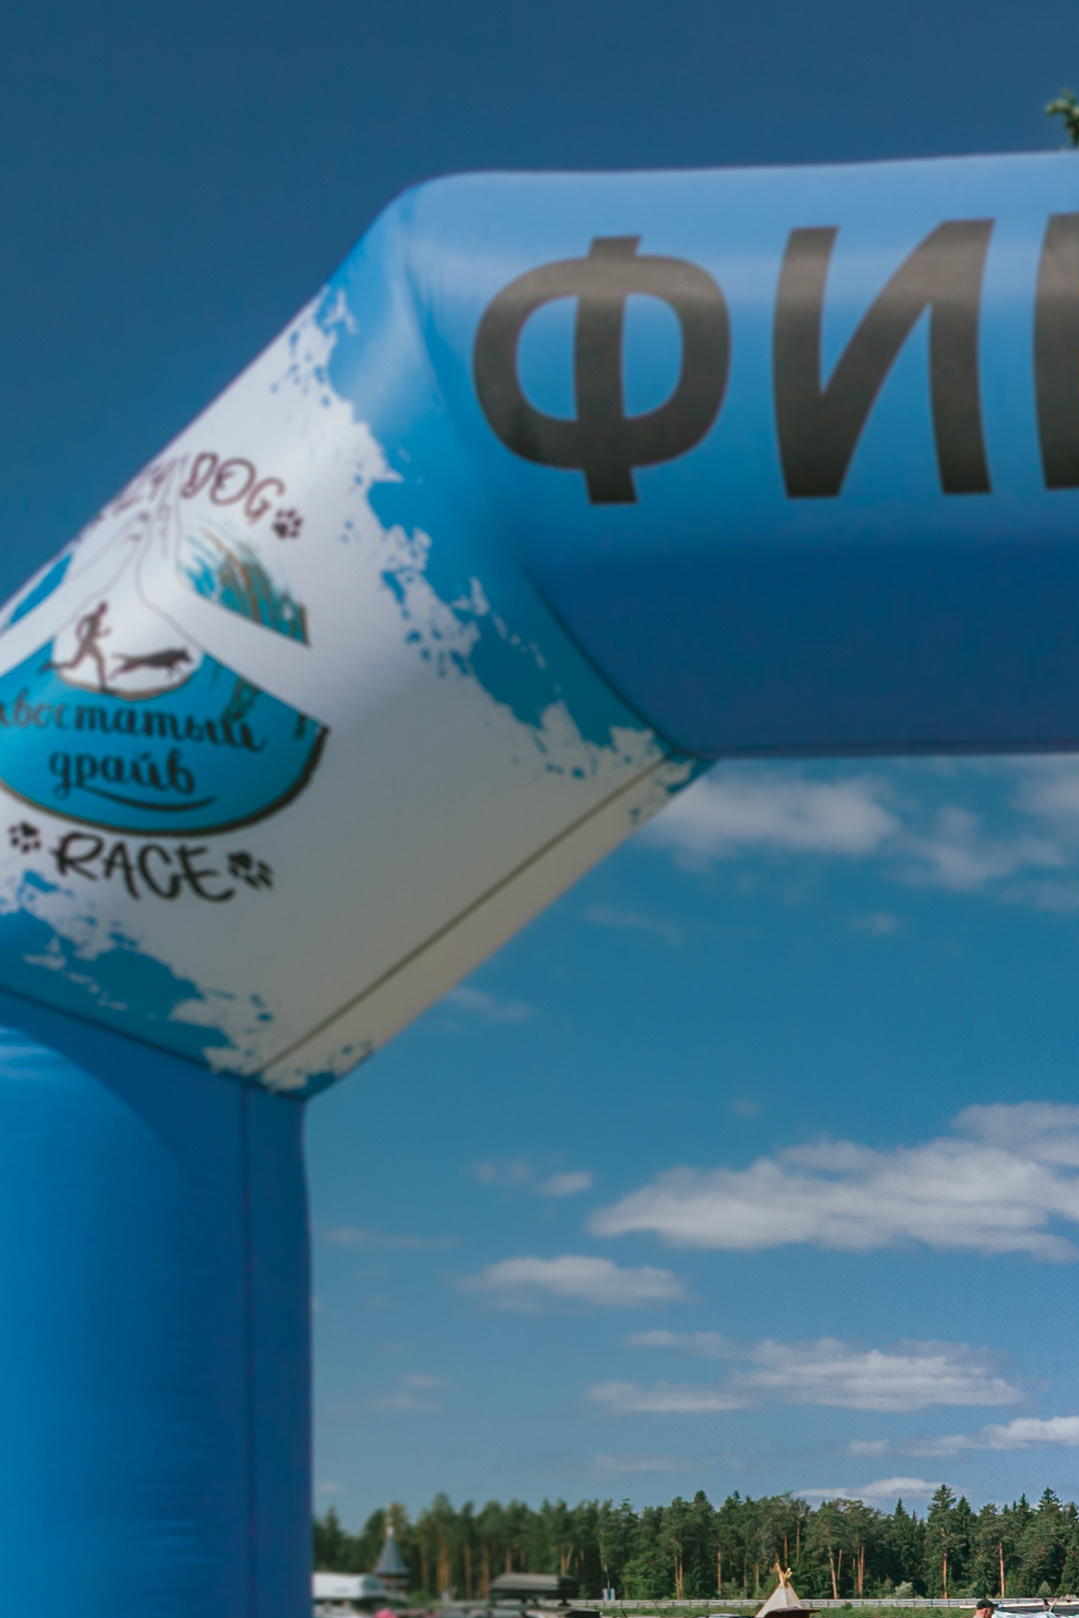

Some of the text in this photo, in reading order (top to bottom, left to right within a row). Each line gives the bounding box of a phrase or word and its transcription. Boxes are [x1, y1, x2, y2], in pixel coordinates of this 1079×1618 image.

[179, 452, 286, 527] DOG
[49, 748, 197, 801] драйв
[52, 832, 236, 902] RACE
